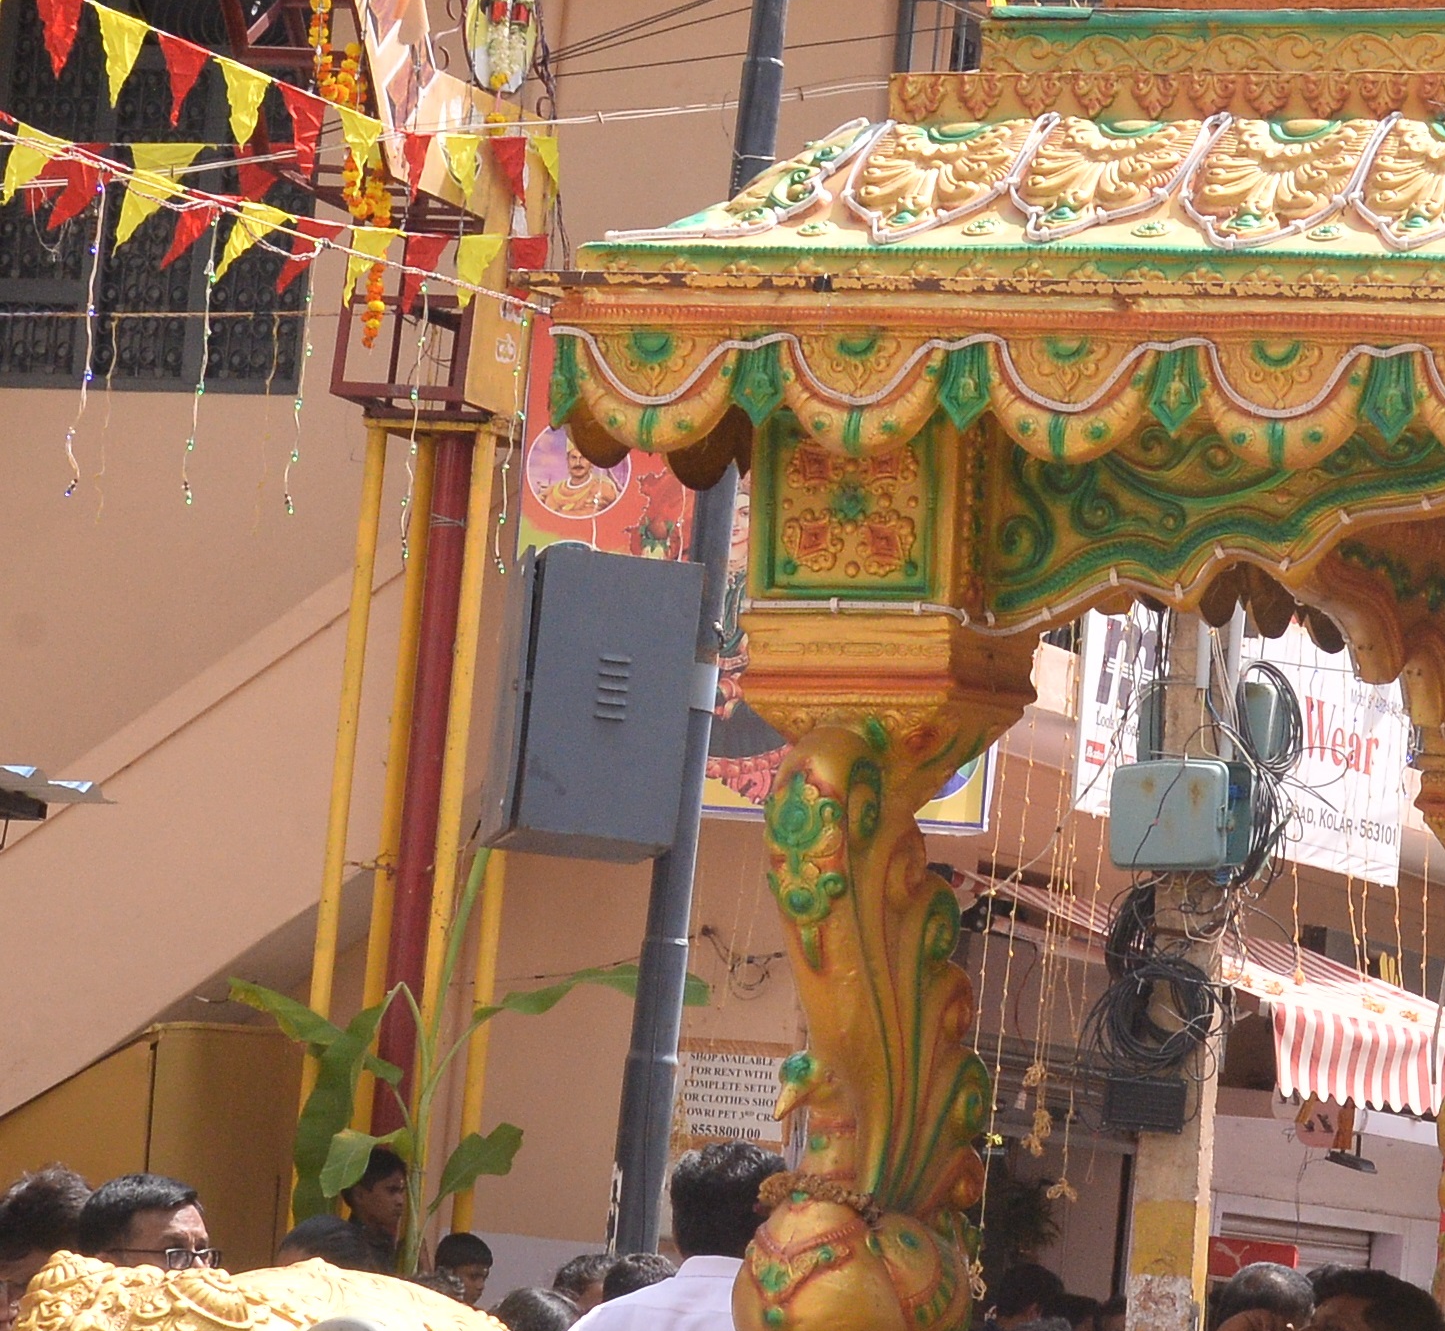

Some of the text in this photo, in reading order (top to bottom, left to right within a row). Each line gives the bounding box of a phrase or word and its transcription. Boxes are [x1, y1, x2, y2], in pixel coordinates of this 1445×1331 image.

[1305, 695, 1380, 776] Wear
[690, 1052, 775, 1067] SHOP AVAILABLE
[690, 1065, 773, 1080] FOR RENT WITH
[684, 1079, 777, 1094] COMPLETE SETUP
[701, 1093, 750, 1106] CLOTHES
